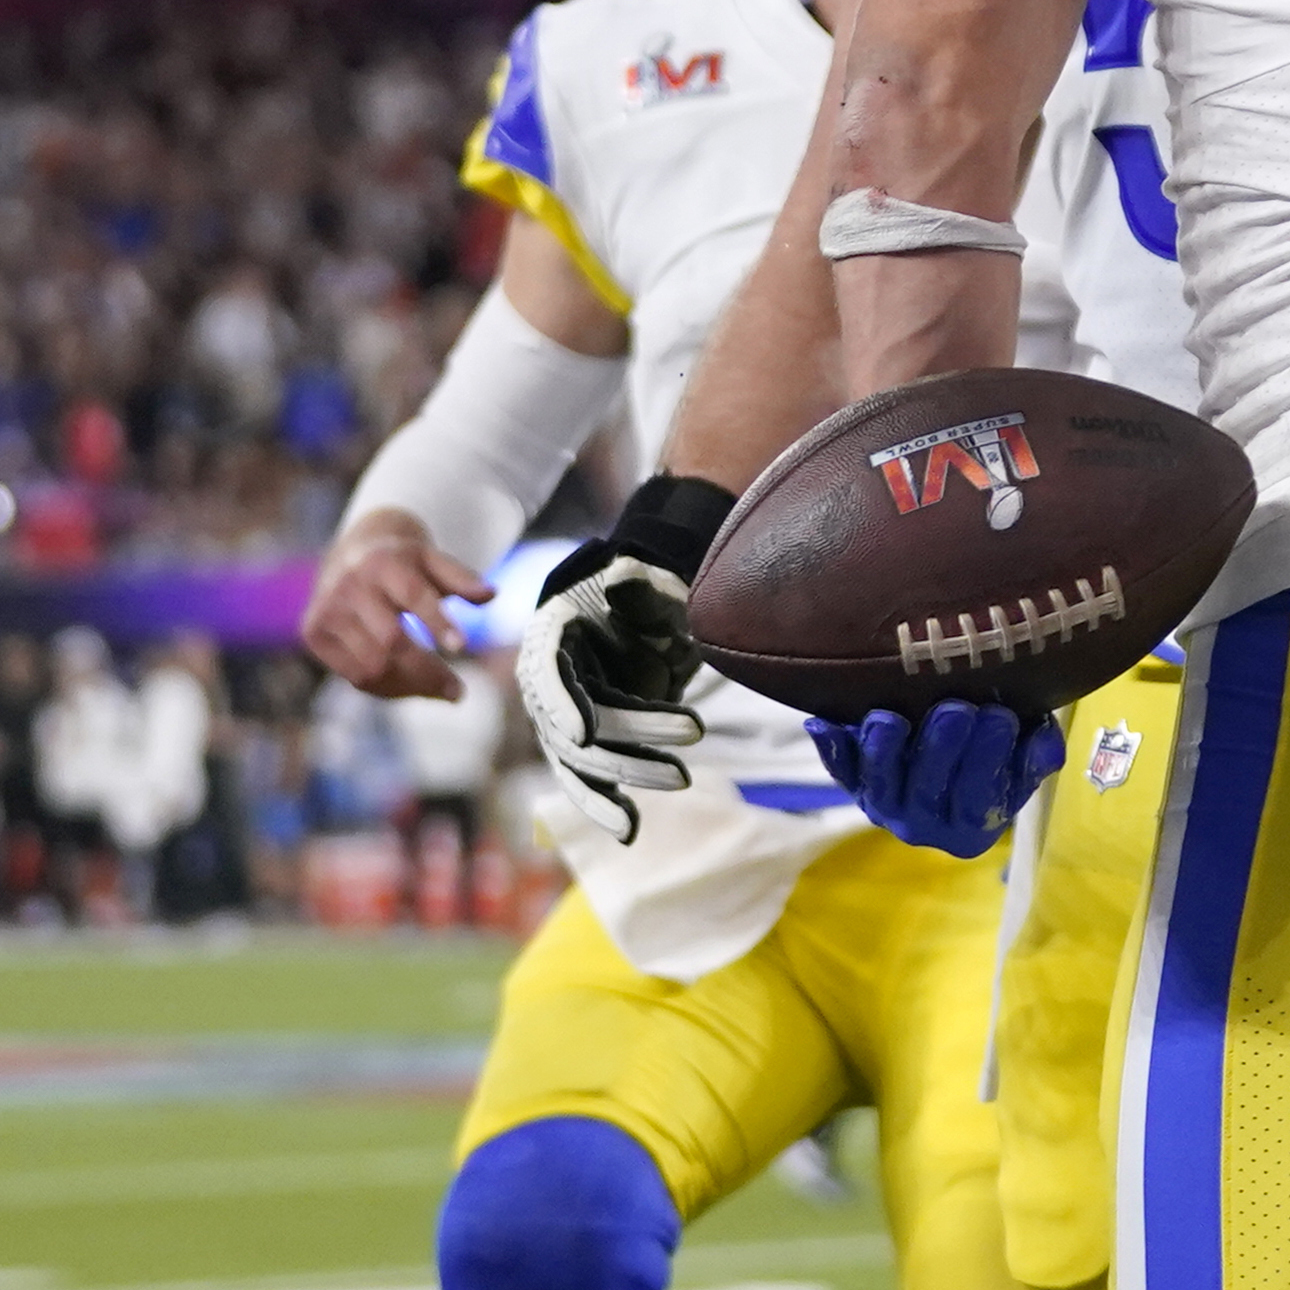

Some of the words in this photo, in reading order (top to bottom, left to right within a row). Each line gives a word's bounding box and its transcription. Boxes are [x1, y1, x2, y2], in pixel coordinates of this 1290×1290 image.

[948, 416, 1011, 438] SUPER
[885, 433, 940, 457] BOWL
[881, 424, 1041, 515] LVI
